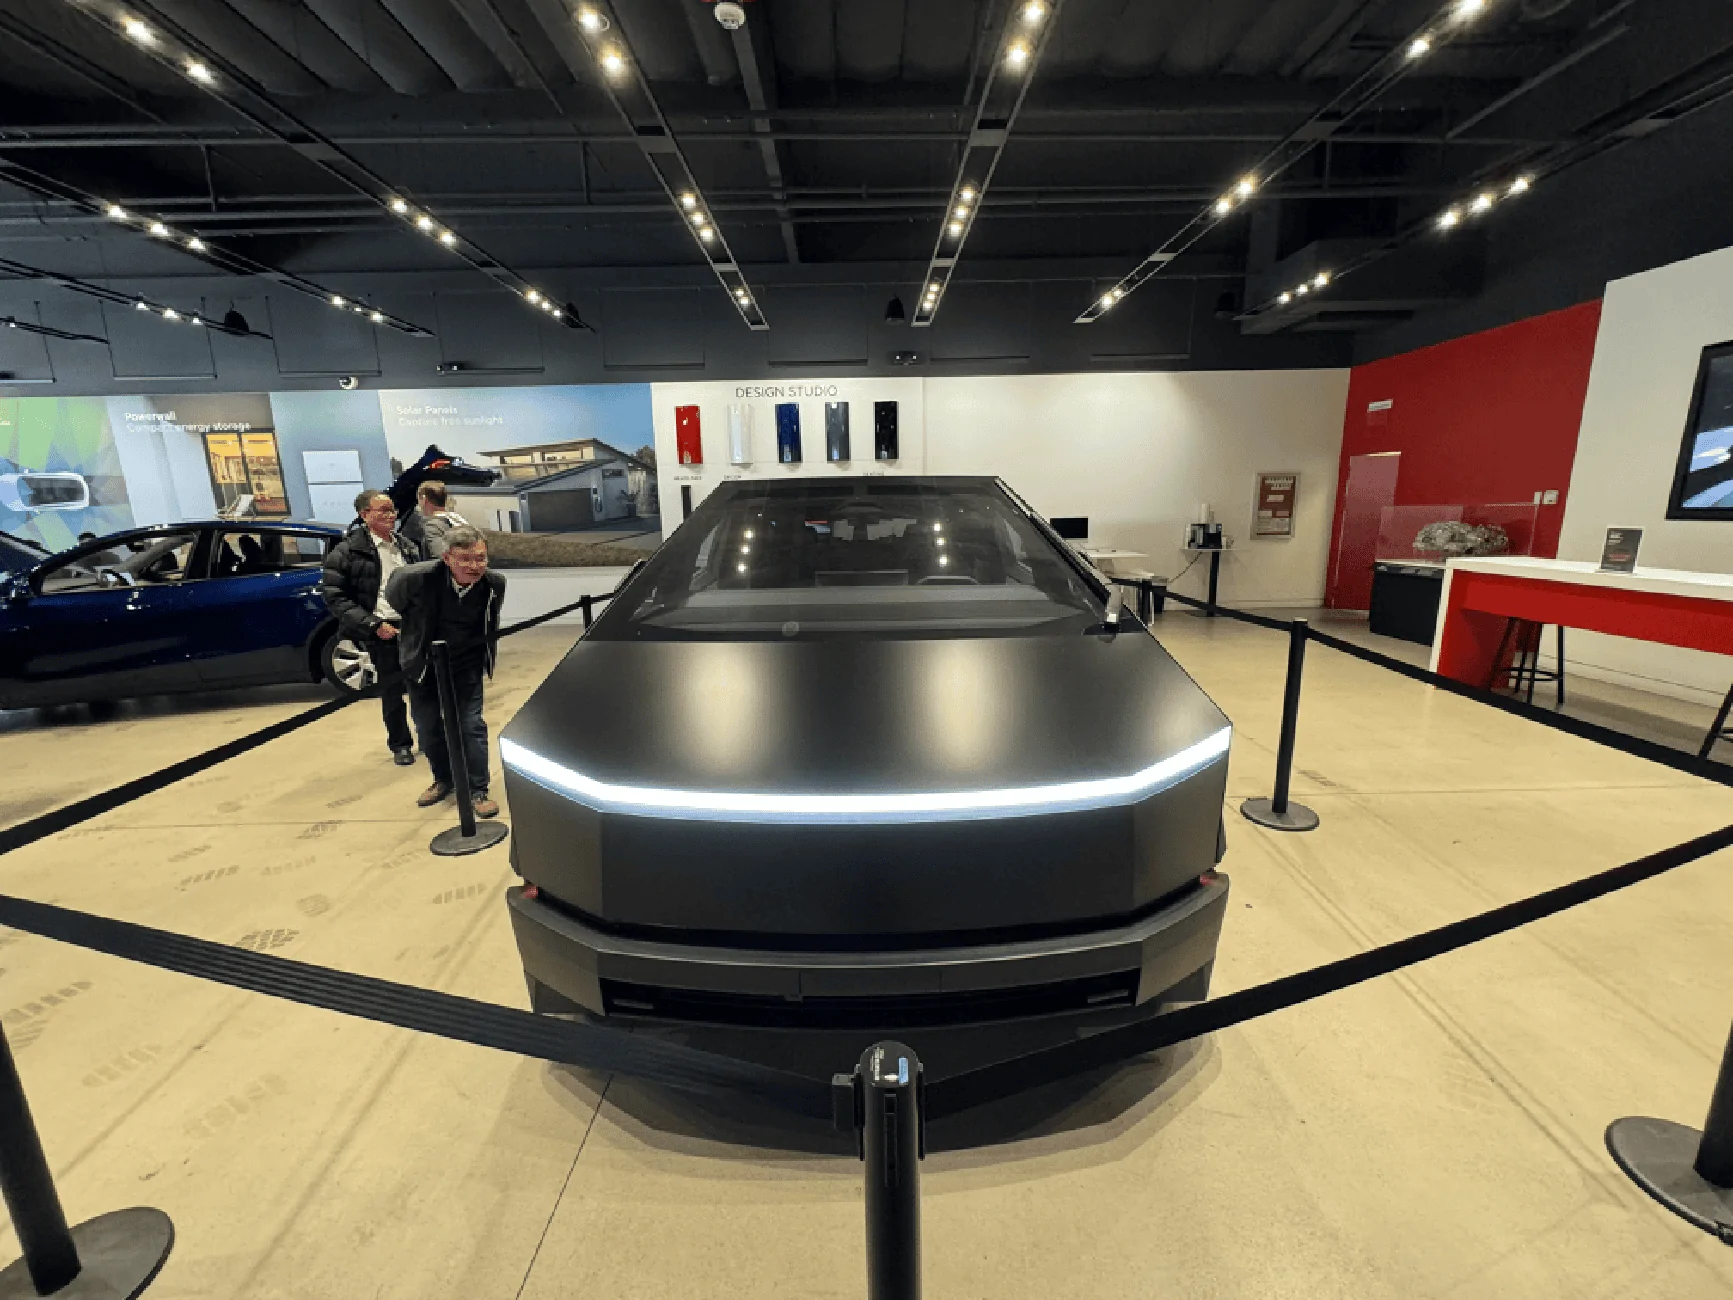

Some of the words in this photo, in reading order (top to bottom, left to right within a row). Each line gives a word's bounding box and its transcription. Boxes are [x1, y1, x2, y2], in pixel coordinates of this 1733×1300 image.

[735, 386, 785, 398] DESIGN
[788, 384, 838, 397] STUDIO
[396, 405, 422, 415] Solar
[424, 405, 458, 415] Panels
[125, 411, 177, 421] Powerwall
[175, 423, 210, 432] energy
[212, 422, 251, 432] storage
